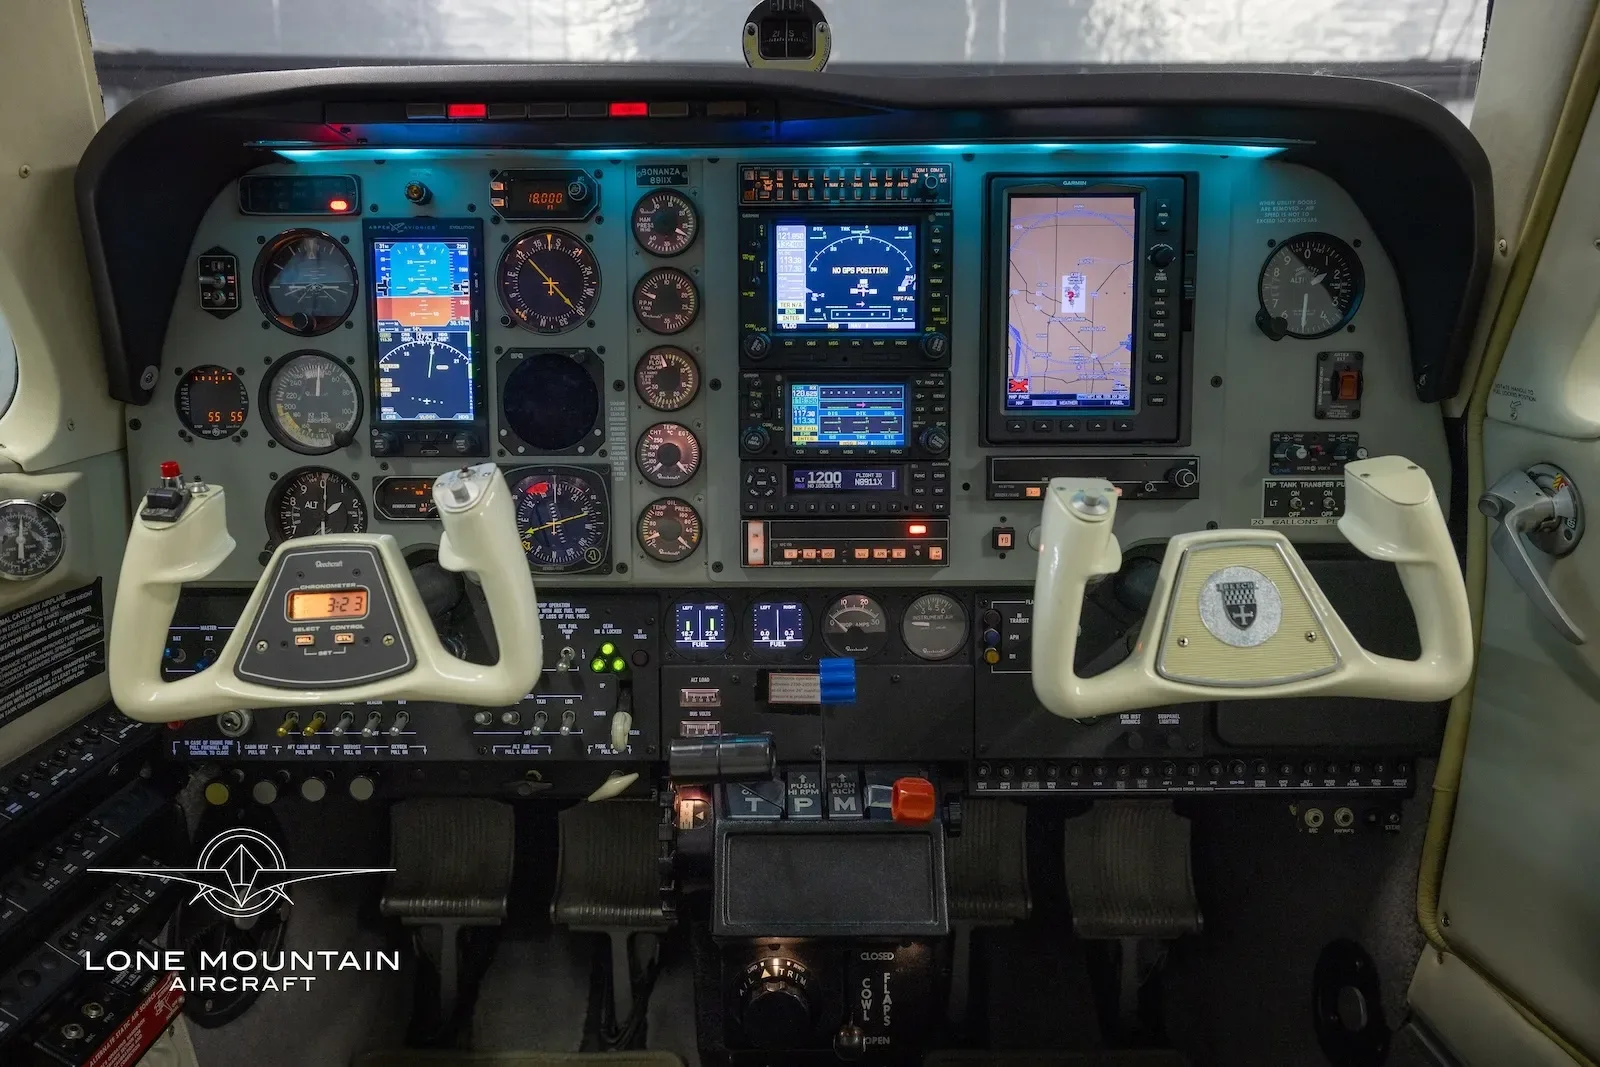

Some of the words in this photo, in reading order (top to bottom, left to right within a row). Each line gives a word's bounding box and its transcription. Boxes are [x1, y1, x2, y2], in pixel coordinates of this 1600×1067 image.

[808, 471, 842, 484] 1200
[855, 478, 883, 486] N8911X
[315, 560, 343, 568] Beechcraft
[300, 582, 356, 590] CHRONOMETER
[12, 604, 40, 620] CATEGORY
[41, 593, 66, 608] AIRPLANE
[327, 596, 363, 612] 3:23
[745, 799, 764, 812] T
[794, 798, 814, 811] P
[834, 797, 856, 810] M
[860, 952, 894, 961] CLOSED
[779, 968, 807, 986] TRIM
[861, 978, 872, 1022] COWL
[882, 973, 892, 1026] FLAPS
[89, 1037, 115, 1067] ALTERNATE
[116, 1020, 130, 1038] STATIC
[131, 1010, 139, 1022] AIR
[140, 992, 156, 1012] SOURCE
